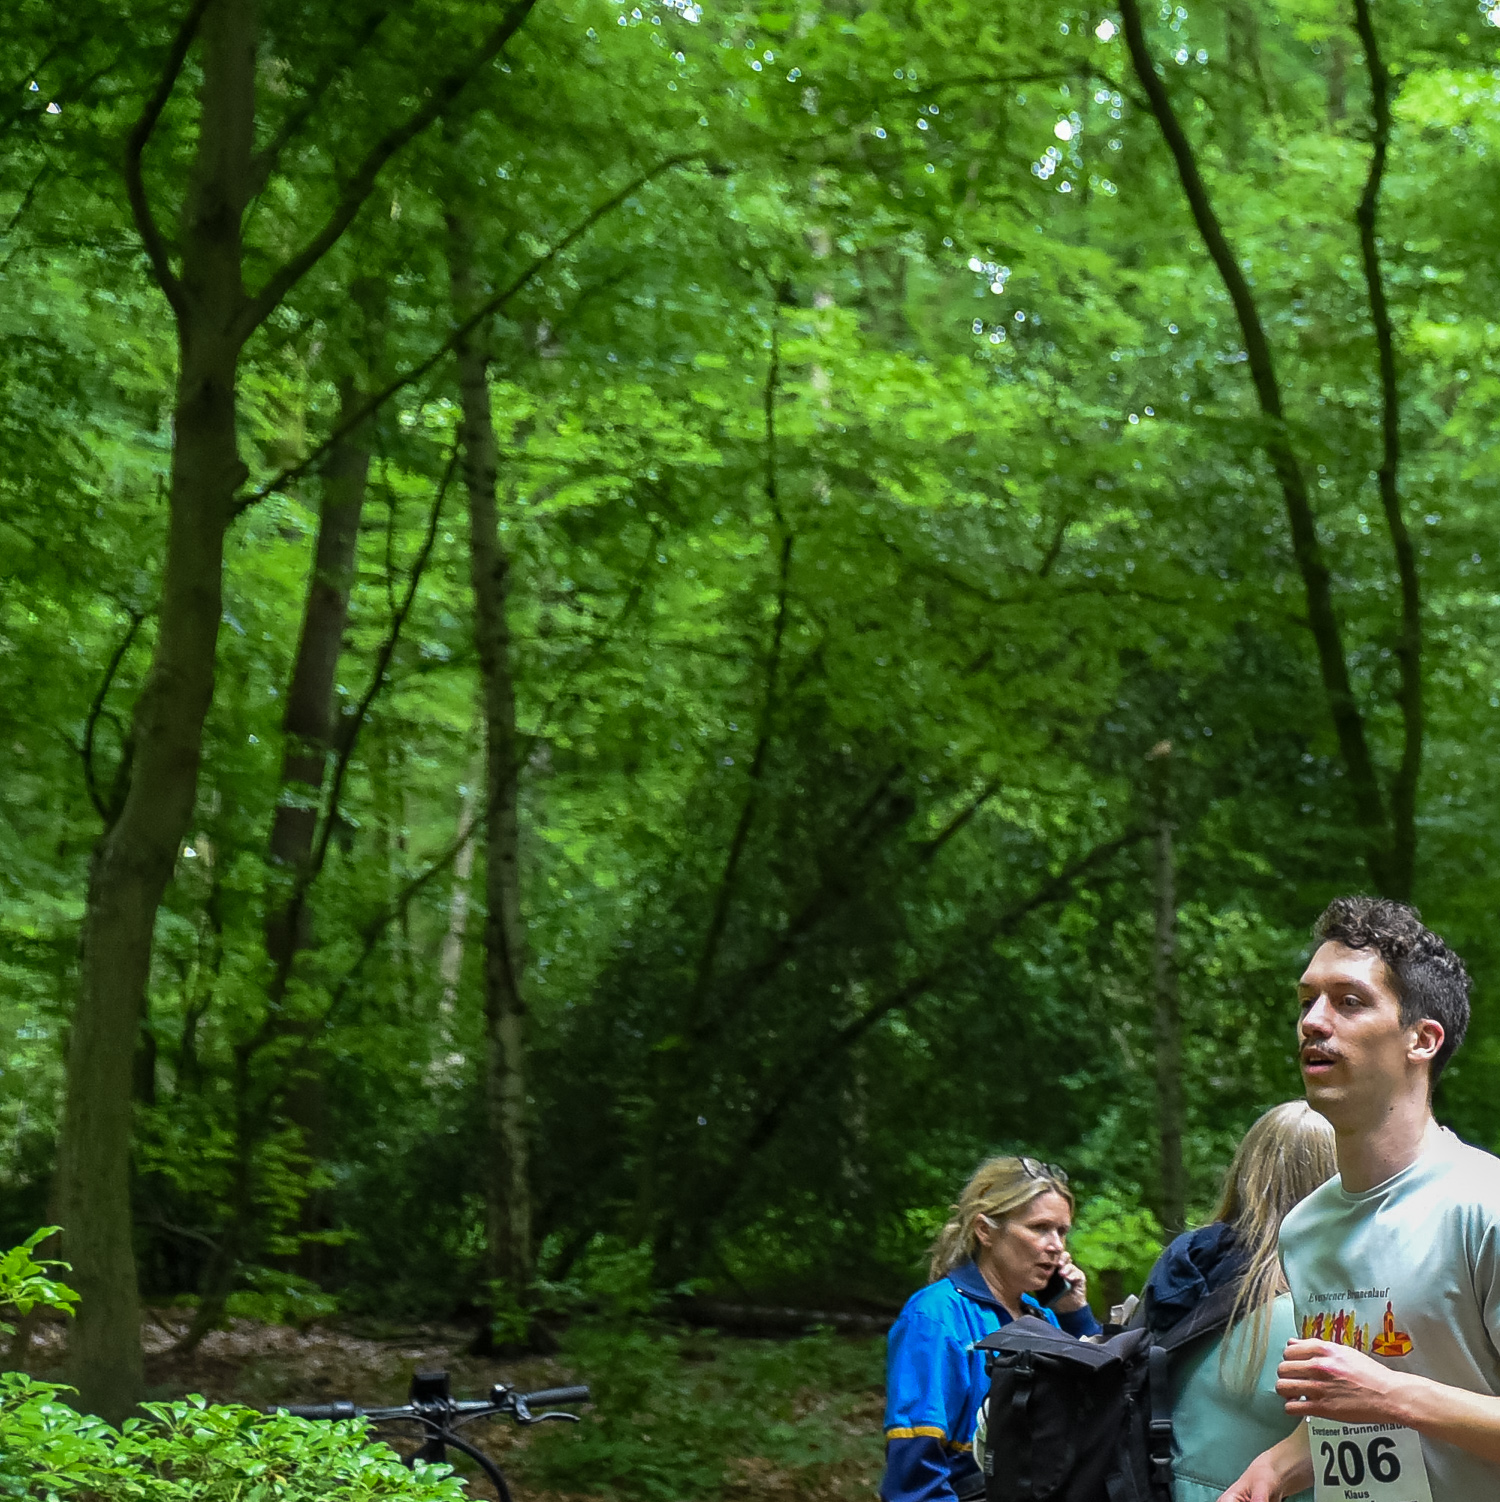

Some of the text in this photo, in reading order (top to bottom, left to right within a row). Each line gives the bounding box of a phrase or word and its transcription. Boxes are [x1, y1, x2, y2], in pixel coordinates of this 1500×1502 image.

[1342, 1423, 1408, 1436] Brunnenlau
[1320, 1436, 1401, 1487] 206
[1344, 1489, 1370, 1500] Klaus
